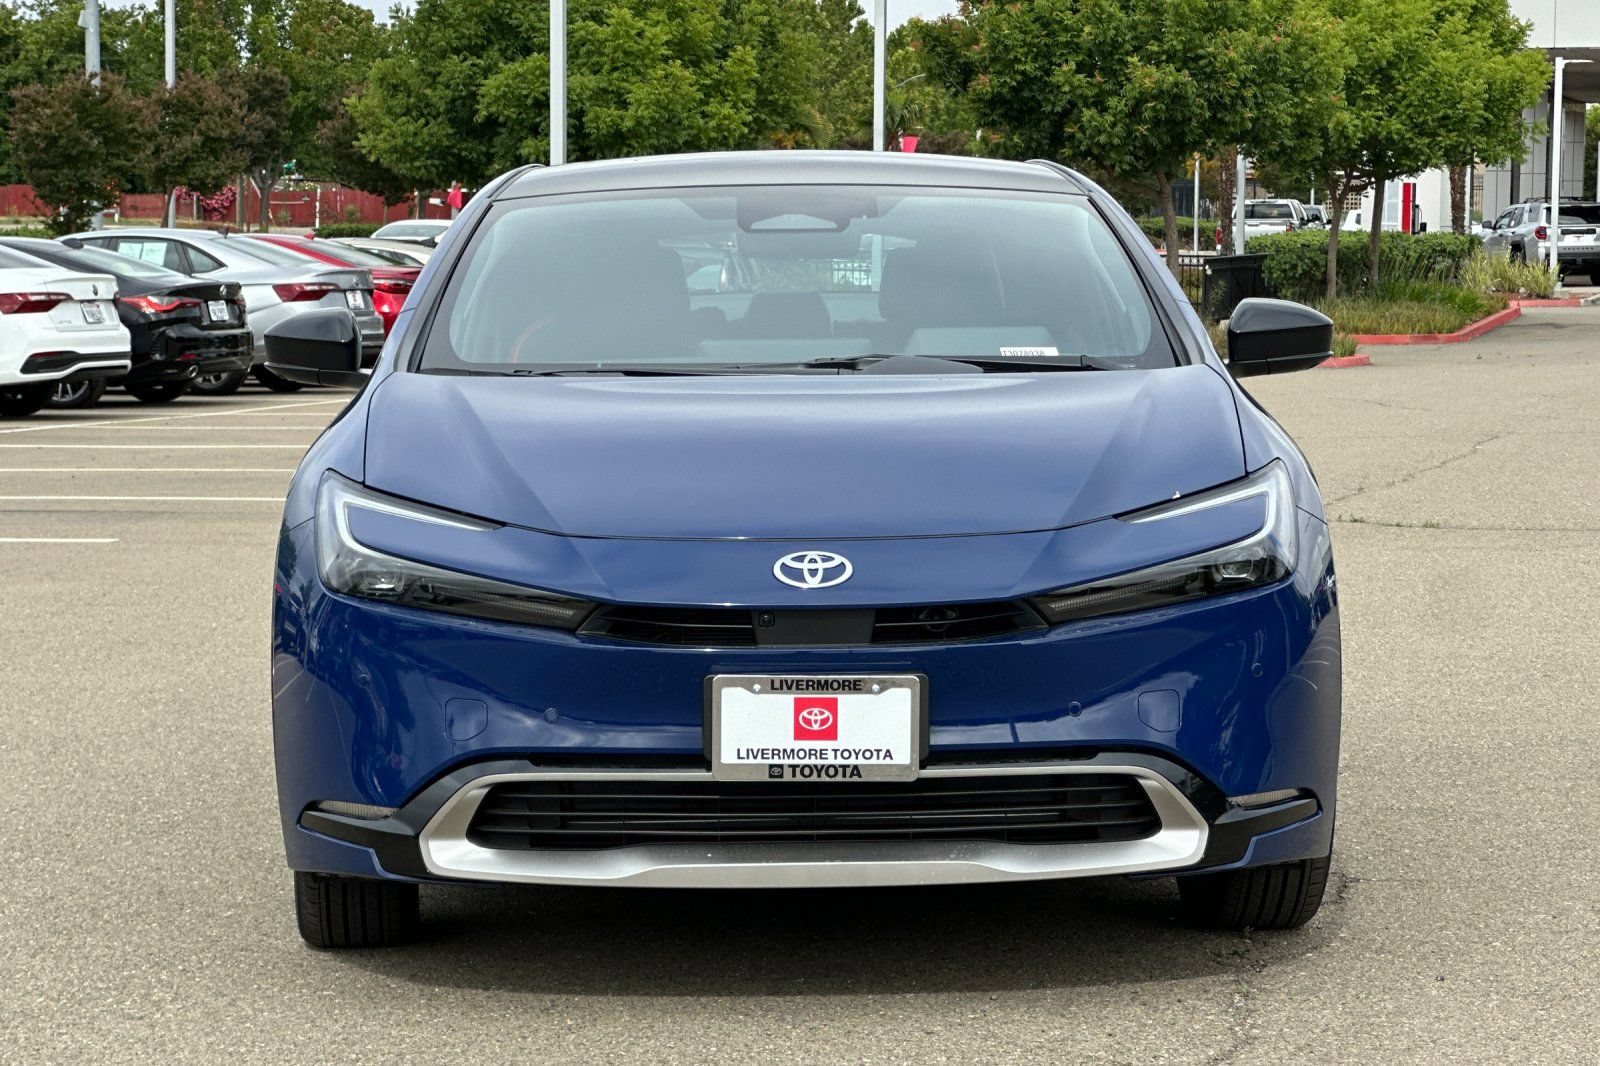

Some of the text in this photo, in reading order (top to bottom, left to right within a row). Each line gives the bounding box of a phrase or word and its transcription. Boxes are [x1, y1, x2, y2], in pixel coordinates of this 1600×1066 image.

[770, 679, 863, 691] LIVERMORE
[736, 748, 894, 761] LIVERMORE TOYOTA
[788, 764, 863, 779] TOYOTA
